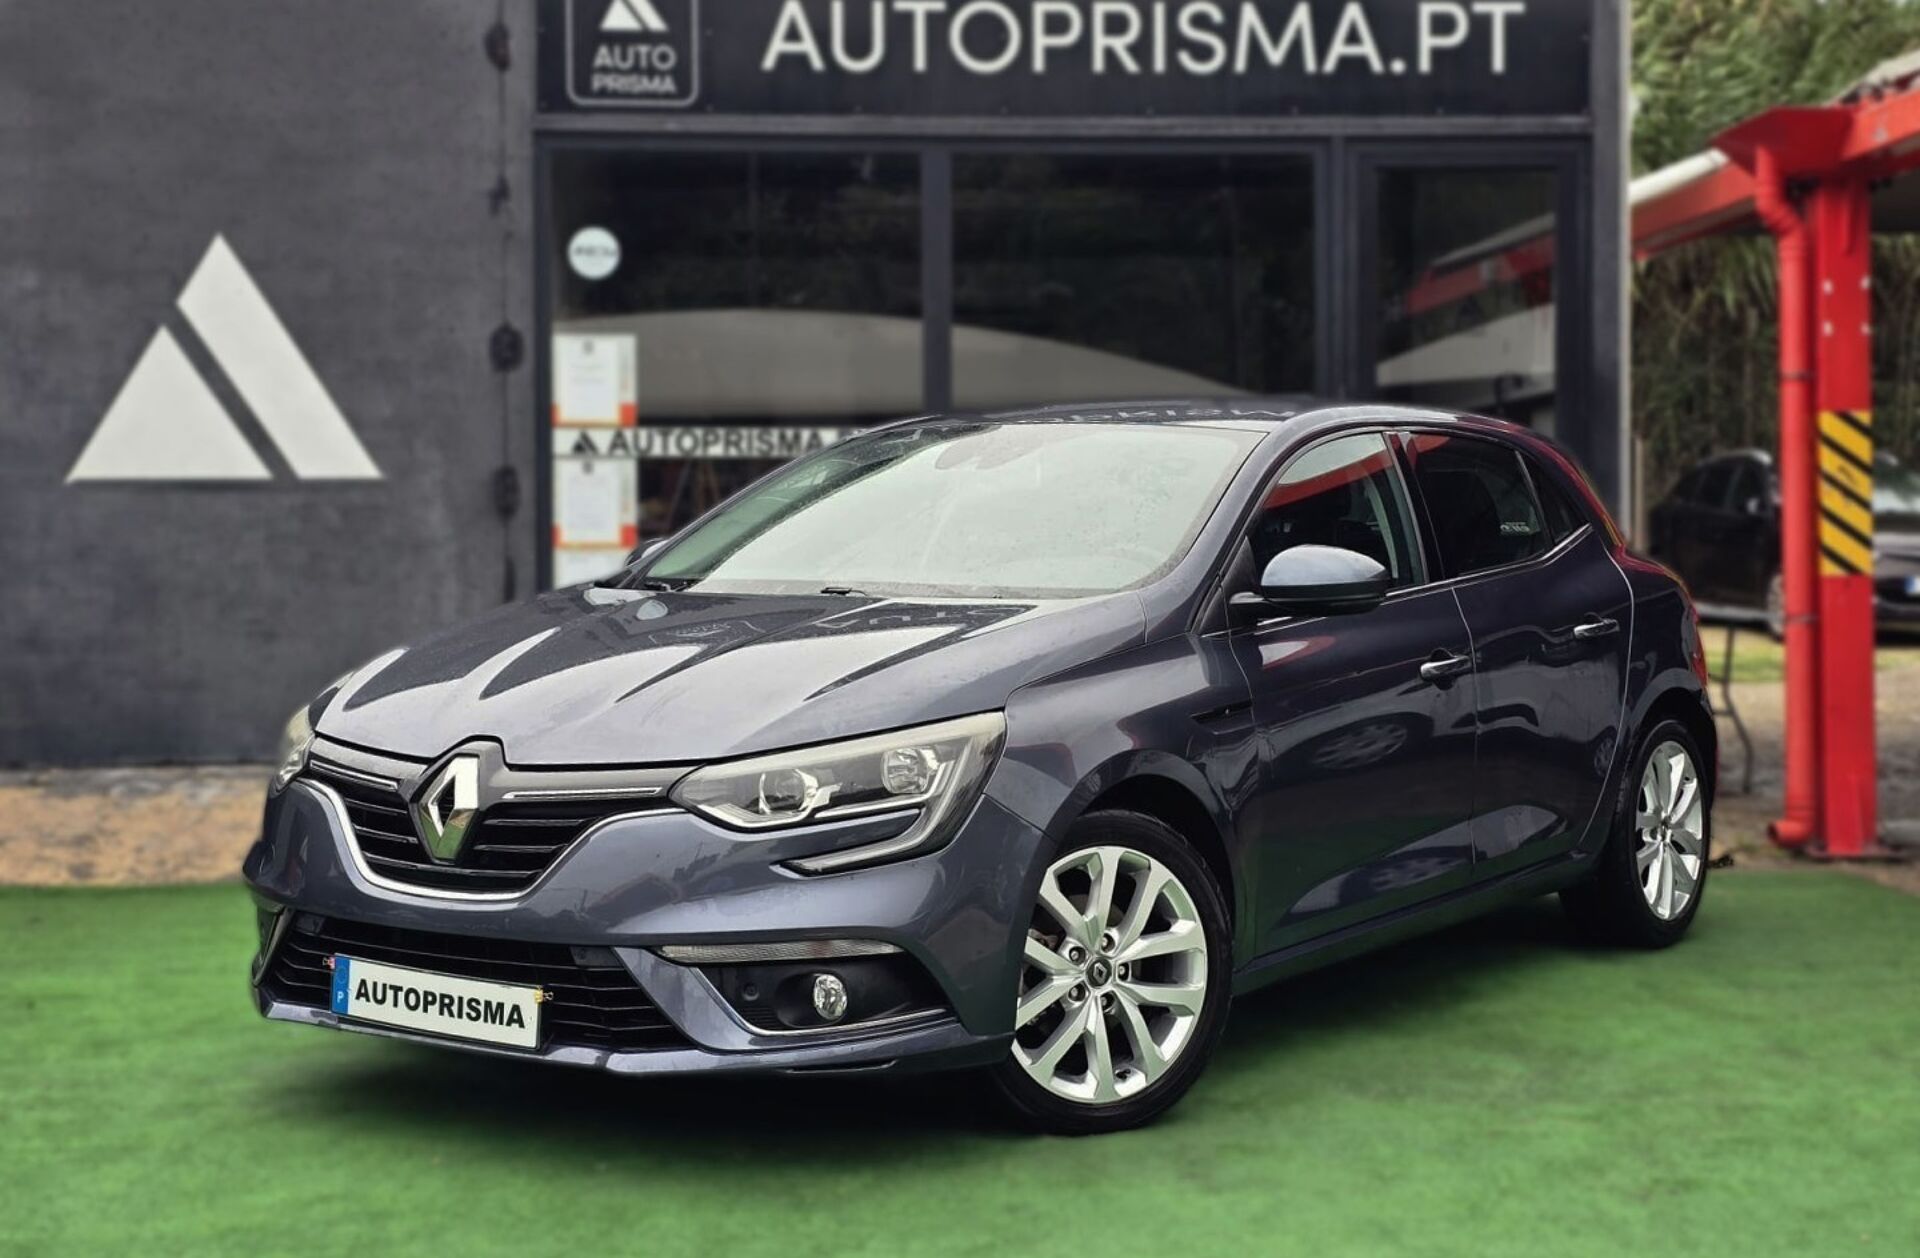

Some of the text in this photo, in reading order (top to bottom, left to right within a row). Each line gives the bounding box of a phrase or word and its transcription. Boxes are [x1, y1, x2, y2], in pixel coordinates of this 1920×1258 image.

[762, 0, 1526, 75] AUTOPRISMA.PT
[592, 43, 678, 71] AUTO
[591, 73, 678, 94] PRISMA
[607, 427, 825, 457] AUTOPRISMA
[355, 978, 526, 1029] AUTOPRISMA
